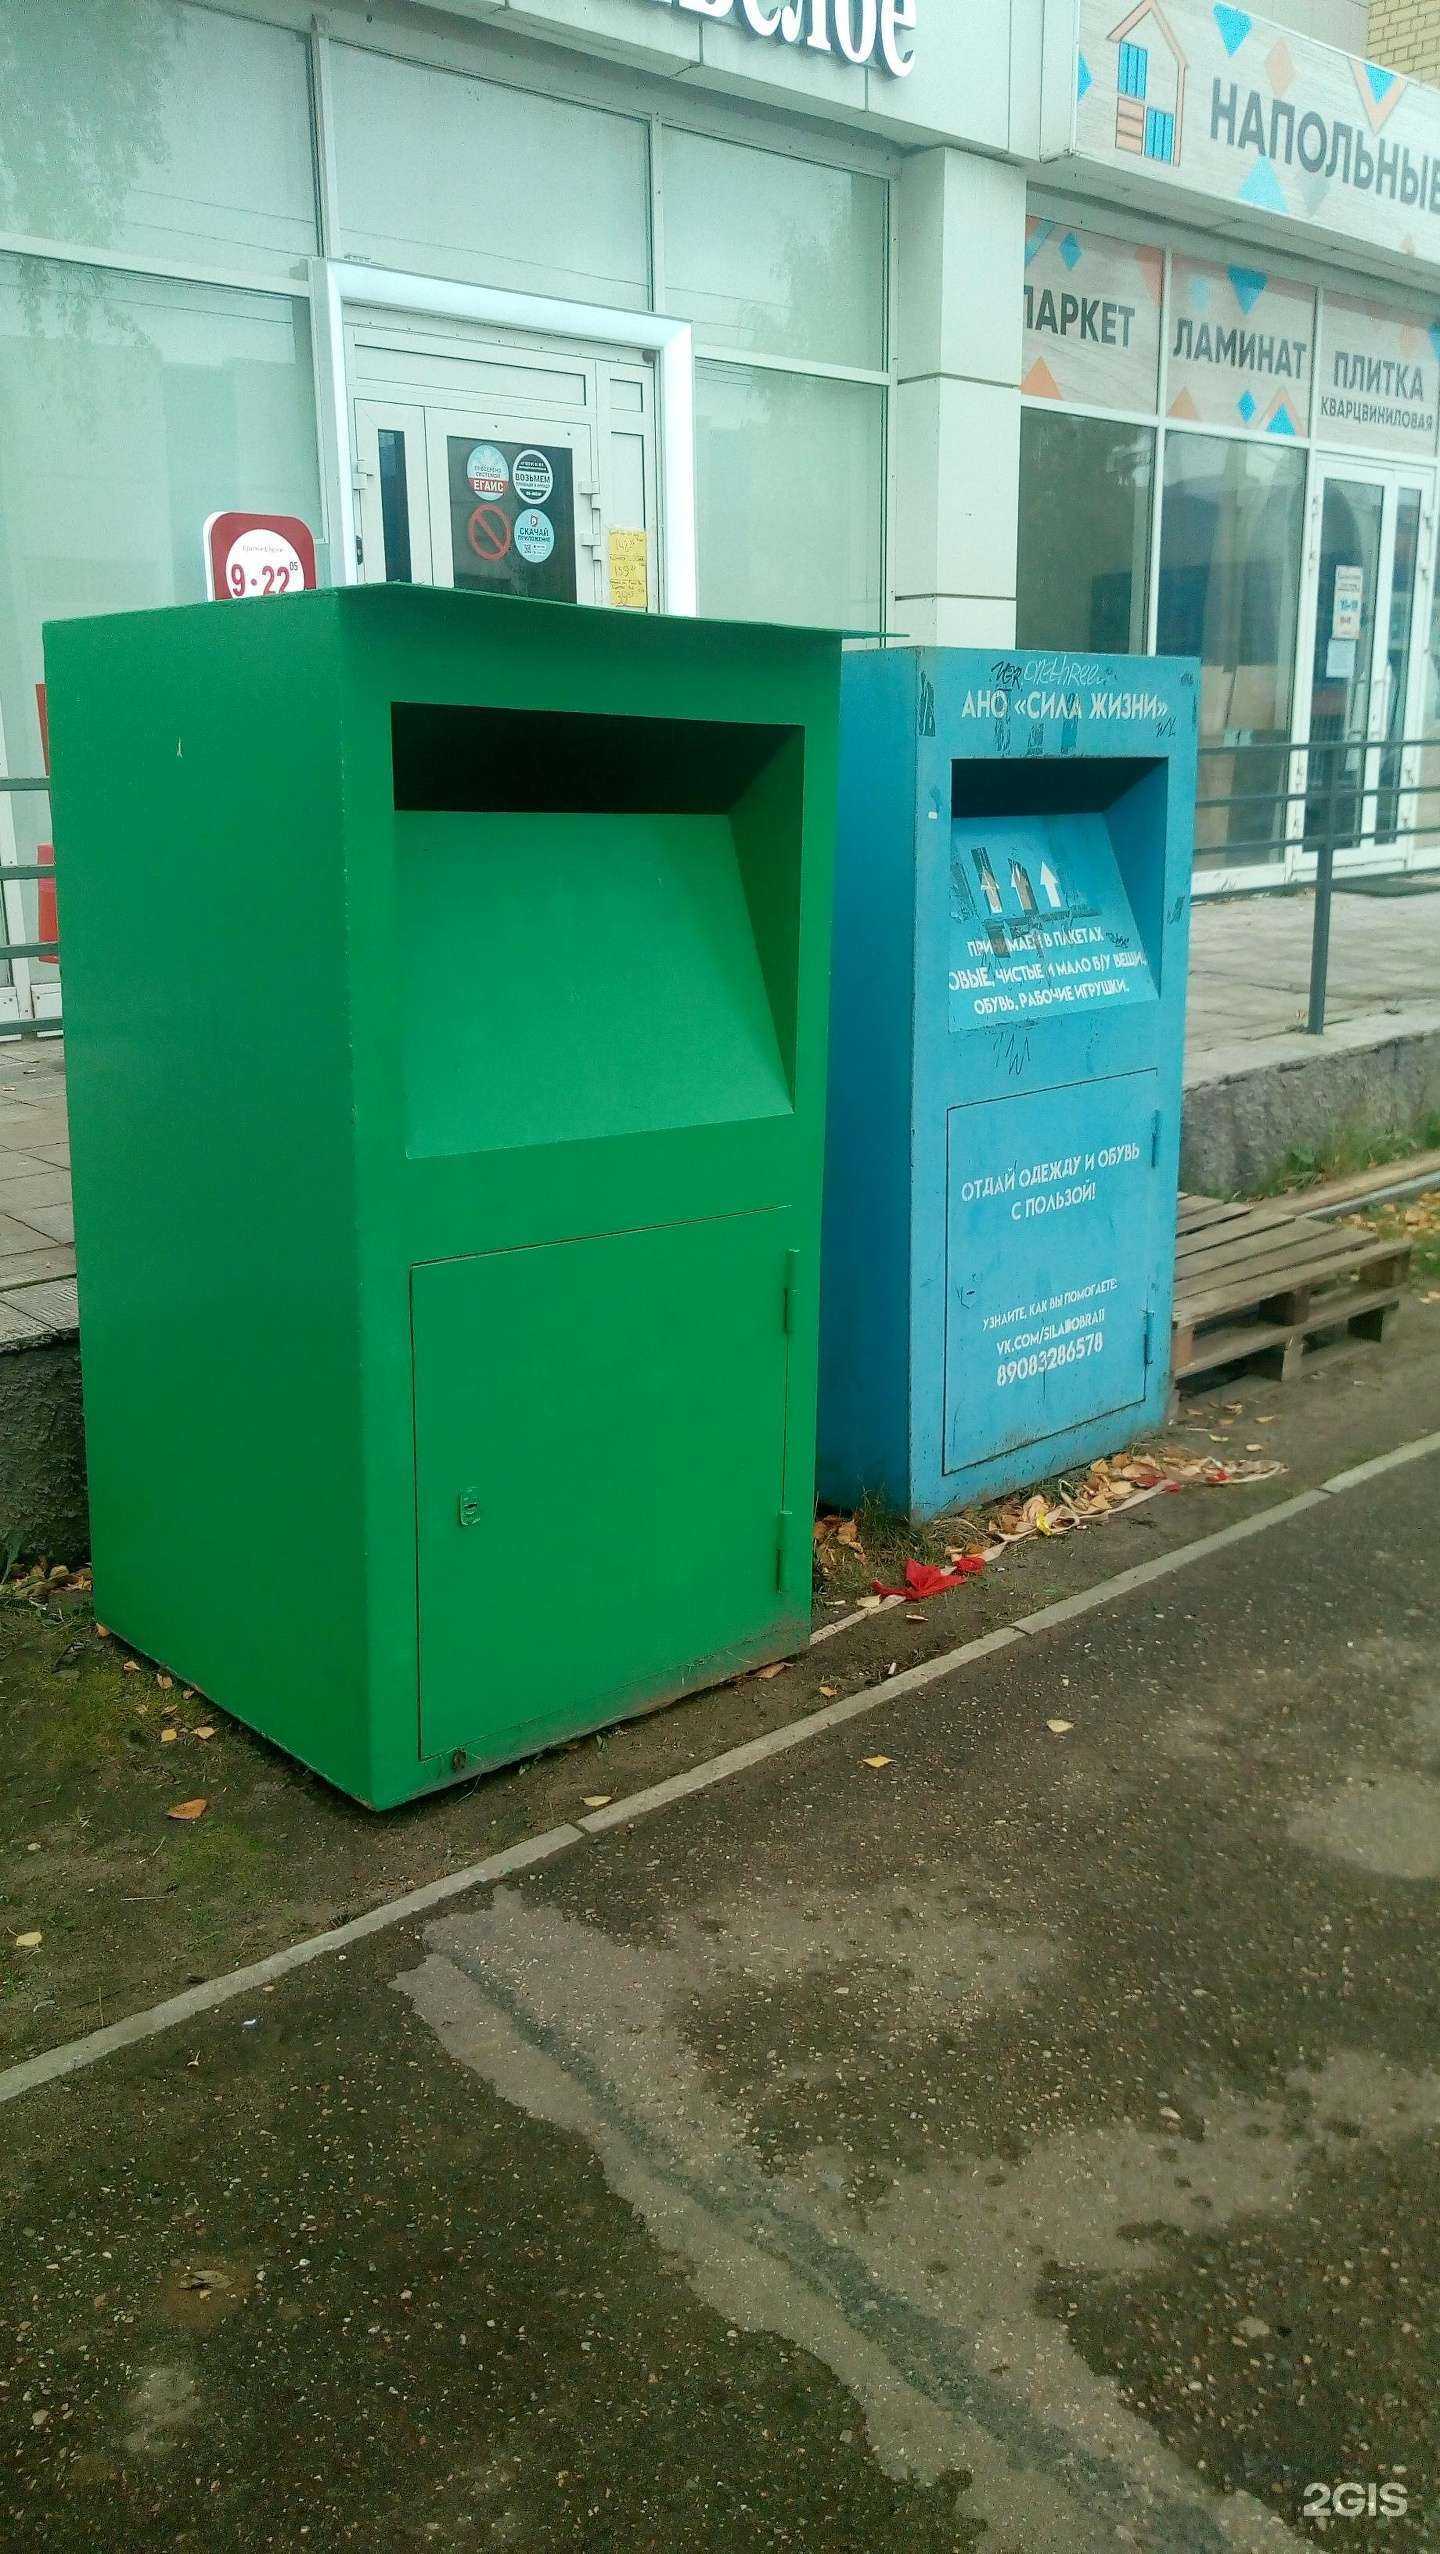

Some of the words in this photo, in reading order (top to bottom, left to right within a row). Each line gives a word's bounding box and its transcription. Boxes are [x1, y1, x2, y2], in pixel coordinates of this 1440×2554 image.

[1173, 317, 1307, 380] ЛАМИНАТ
[1333, 350, 1425, 402] ПЛИТКА
[1321, 395, 1434, 433] КВАРЦВИНИЛОВАЯ
[473, 479, 504, 493] ЕГАИС
[519, 526, 550, 537] СКАЧАЙ
[961, 689, 1009, 719] АНО
[1014, 690, 1083, 720] «СИЛА
[1088, 692, 1169, 720] ЖИЗНИ»
[1044, 930, 1055, 947] В
[1054, 926, 1105, 946] ПАКЕТАХ
[996, 963, 1045, 984] ЧИСТЫЕ
[1056, 956, 1092, 976] МАЛО
[1093, 953, 1111, 973] Б/У
[973, 998, 1019, 1015] ОБУВЬ,
[1018, 985, 1075, 1009] РАБОЧИЕ
[1074, 978, 1131, 1000] ИГРУШКИ.
[961, 1166, 1016, 1202] ОТДАЙ
[1018, 1154, 1082, 1188] ОДЕЖДУ
[1084, 1153, 1096, 1171] И
[1097, 1142, 1141, 1168] ОБУВЬ
[1011, 1202, 1023, 1221] С
[1025, 1178, 1097, 1218] ПОЛЬЗОЙ!
[1029, 1298, 1048, 1317] КАК
[1049, 1294, 1063, 1309] ВЫ
[997, 1332, 1103, 1386] 89083286578
